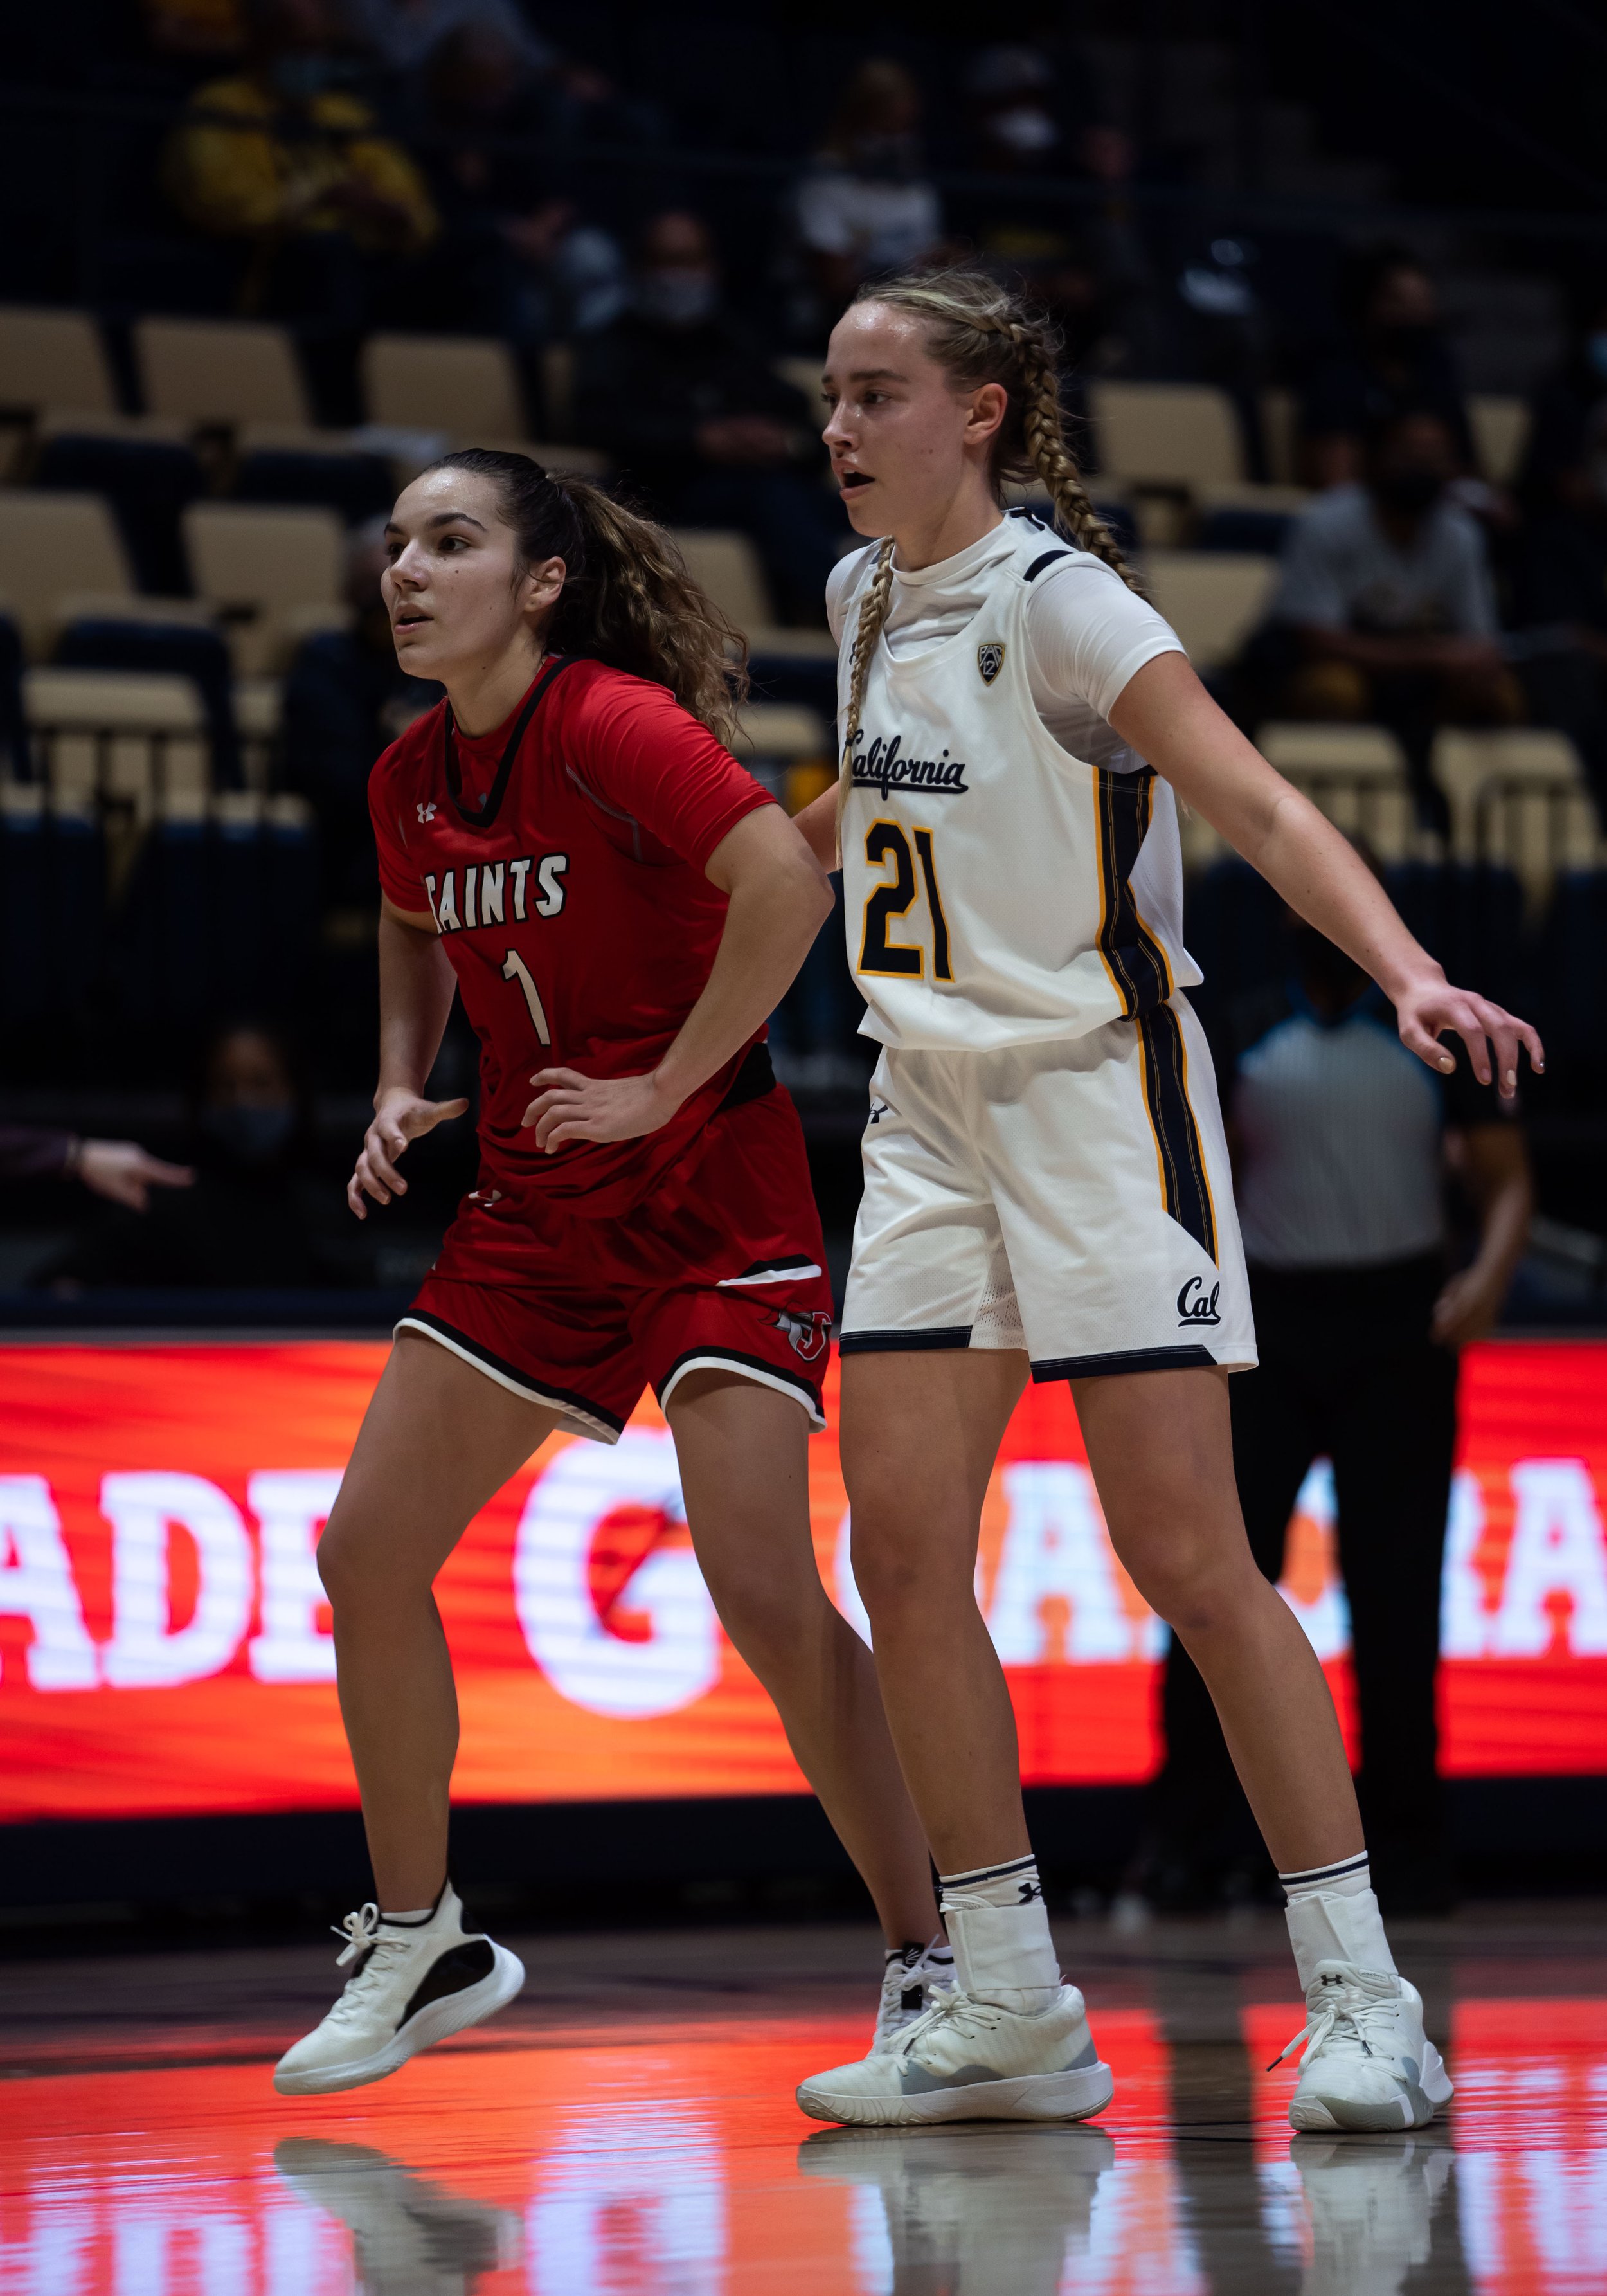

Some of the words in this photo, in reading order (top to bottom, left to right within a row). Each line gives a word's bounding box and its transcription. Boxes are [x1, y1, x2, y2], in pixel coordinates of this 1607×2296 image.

[979, 645, 1003, 667] PAC
[983, 660, 996, 675] 12
[856, 818, 956, 983] 21
[502, 948, 552, 1046] 1
[1176, 1276, 1221, 1328] Cal
